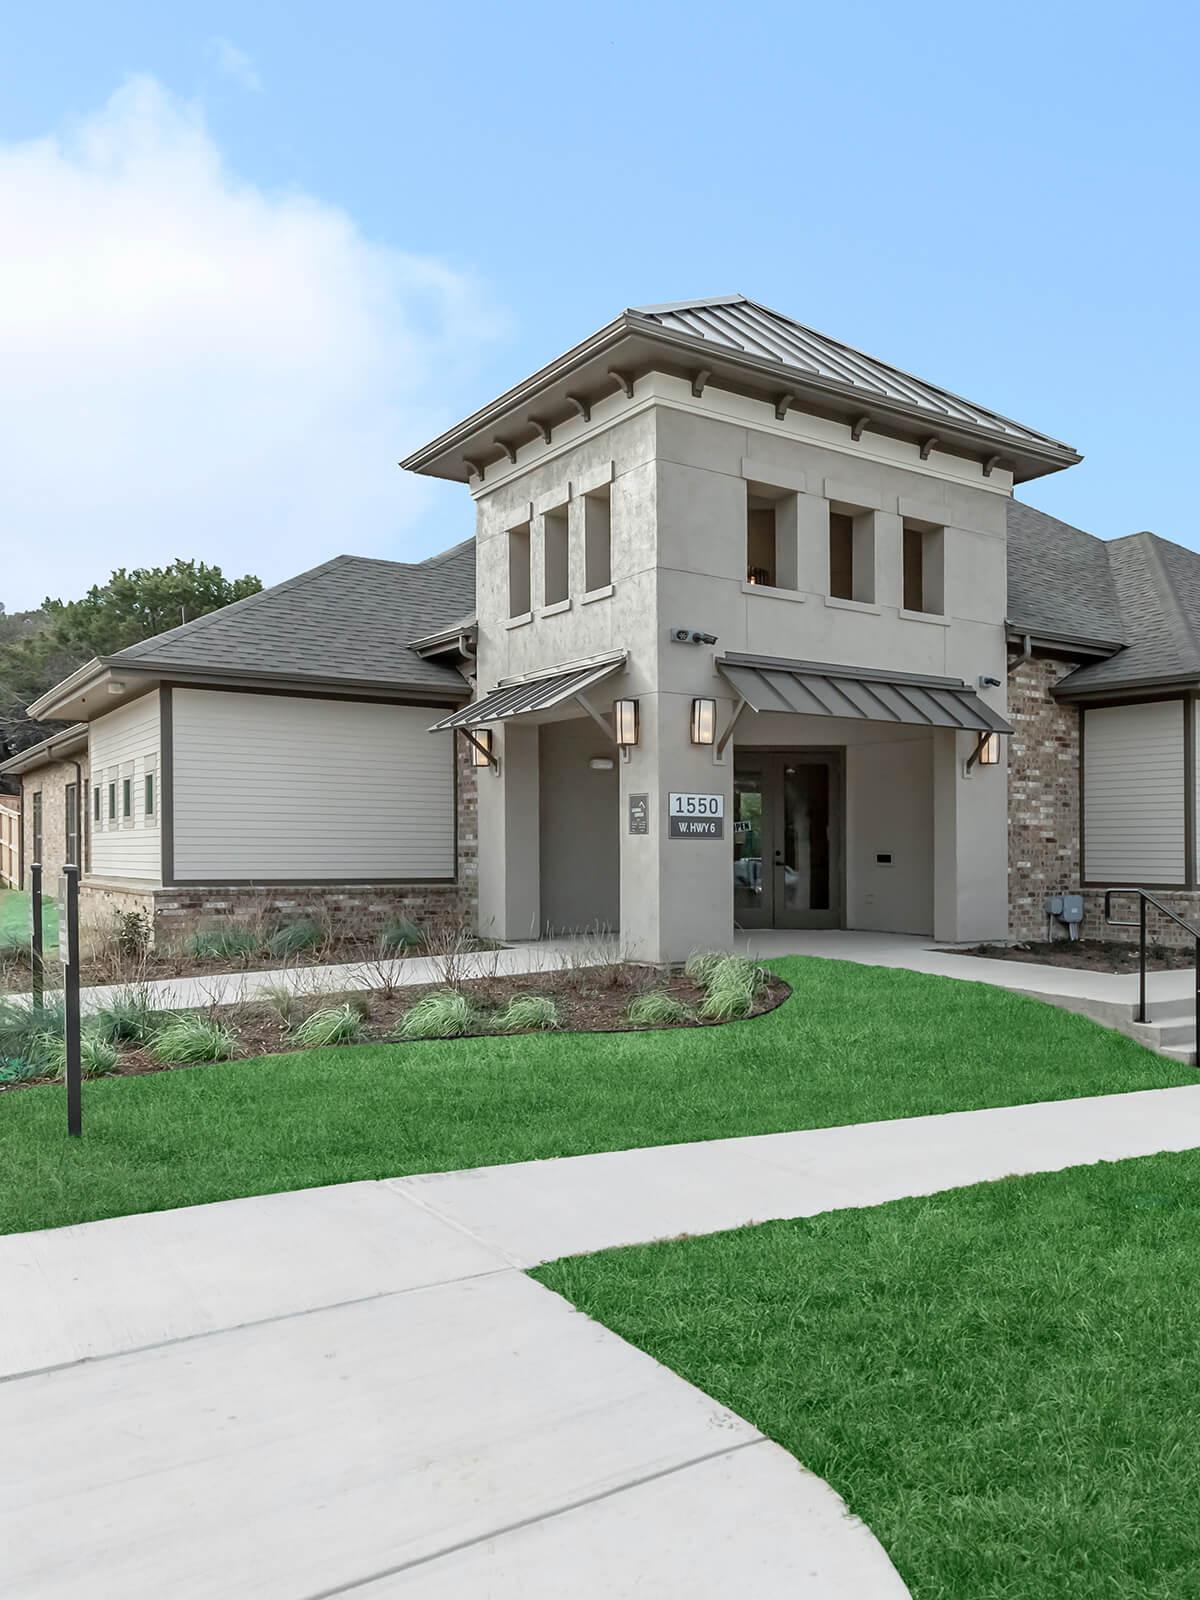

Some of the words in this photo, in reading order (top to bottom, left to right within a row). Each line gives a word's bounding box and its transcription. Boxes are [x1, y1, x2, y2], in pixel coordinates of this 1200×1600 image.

[676, 797, 718, 814] 1550
[690, 822, 709, 833] HWY
[710, 823, 716, 833] 6
[734, 822, 750, 832] PEN
